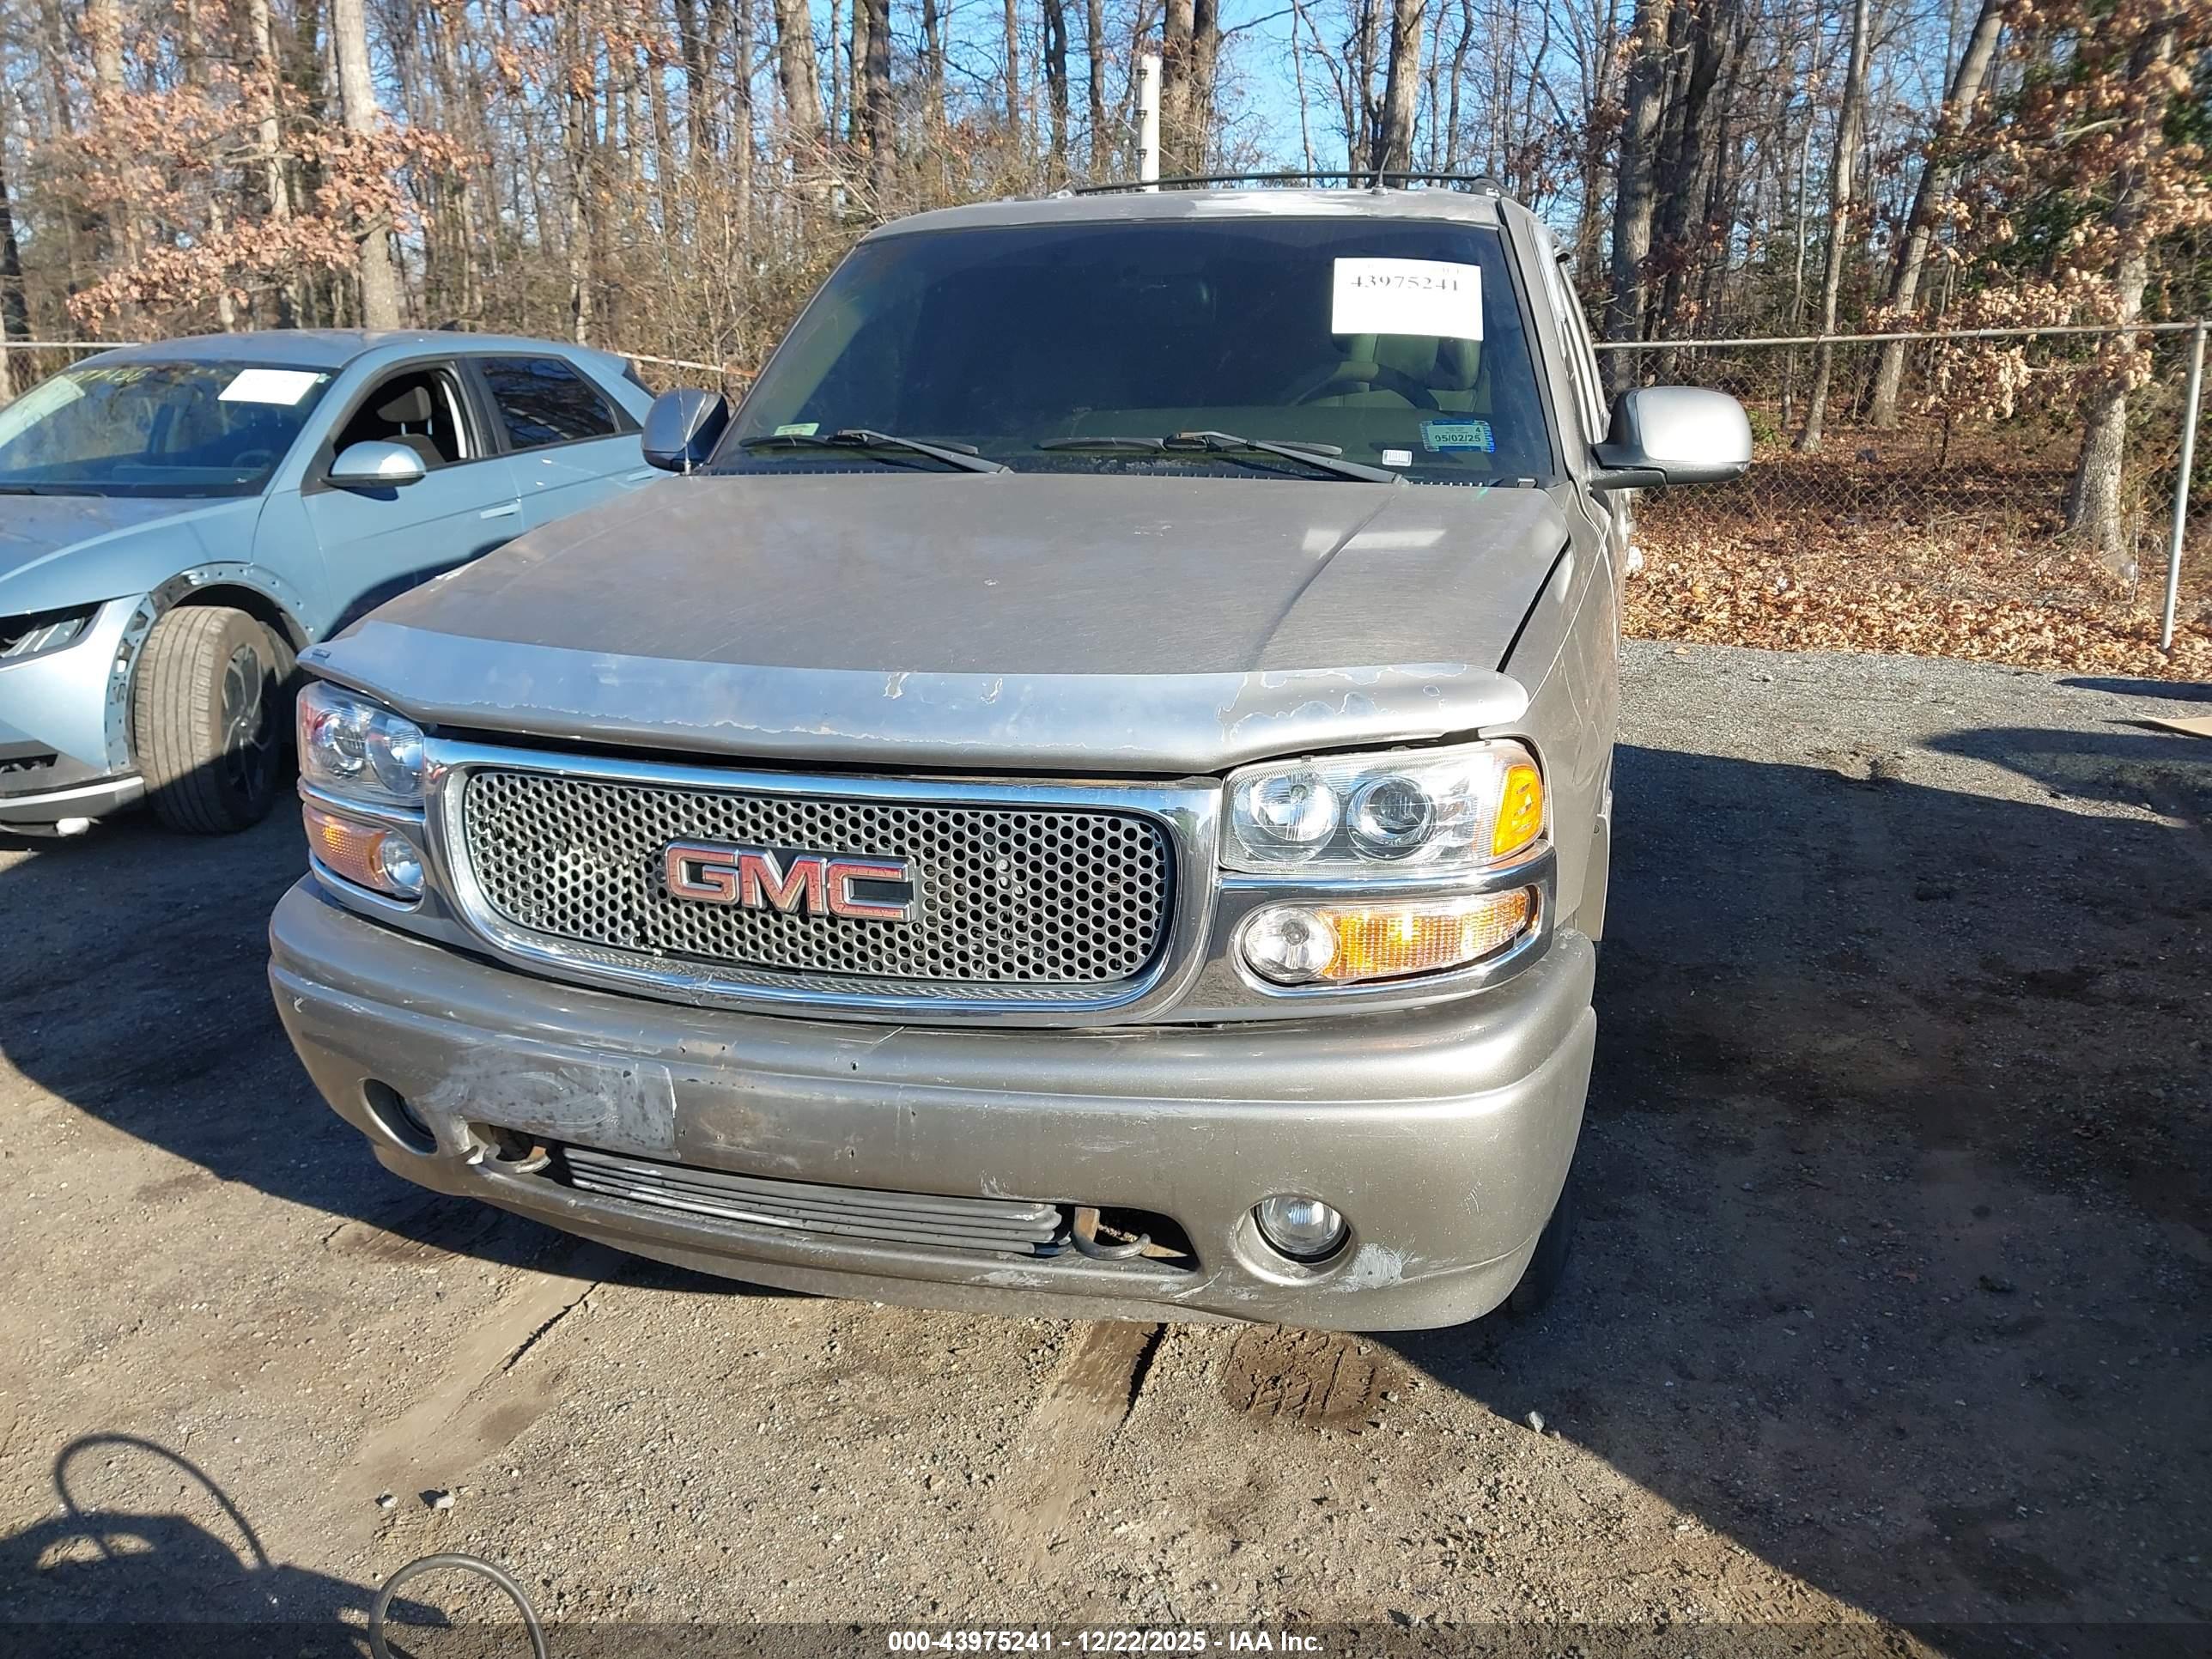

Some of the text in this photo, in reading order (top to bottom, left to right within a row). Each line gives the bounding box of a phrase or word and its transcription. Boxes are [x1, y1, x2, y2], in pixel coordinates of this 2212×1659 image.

[1350, 274, 1458, 292] 43975241
[1434, 434, 1482, 443] 05/02/25
[665, 842, 918, 922] GMC
